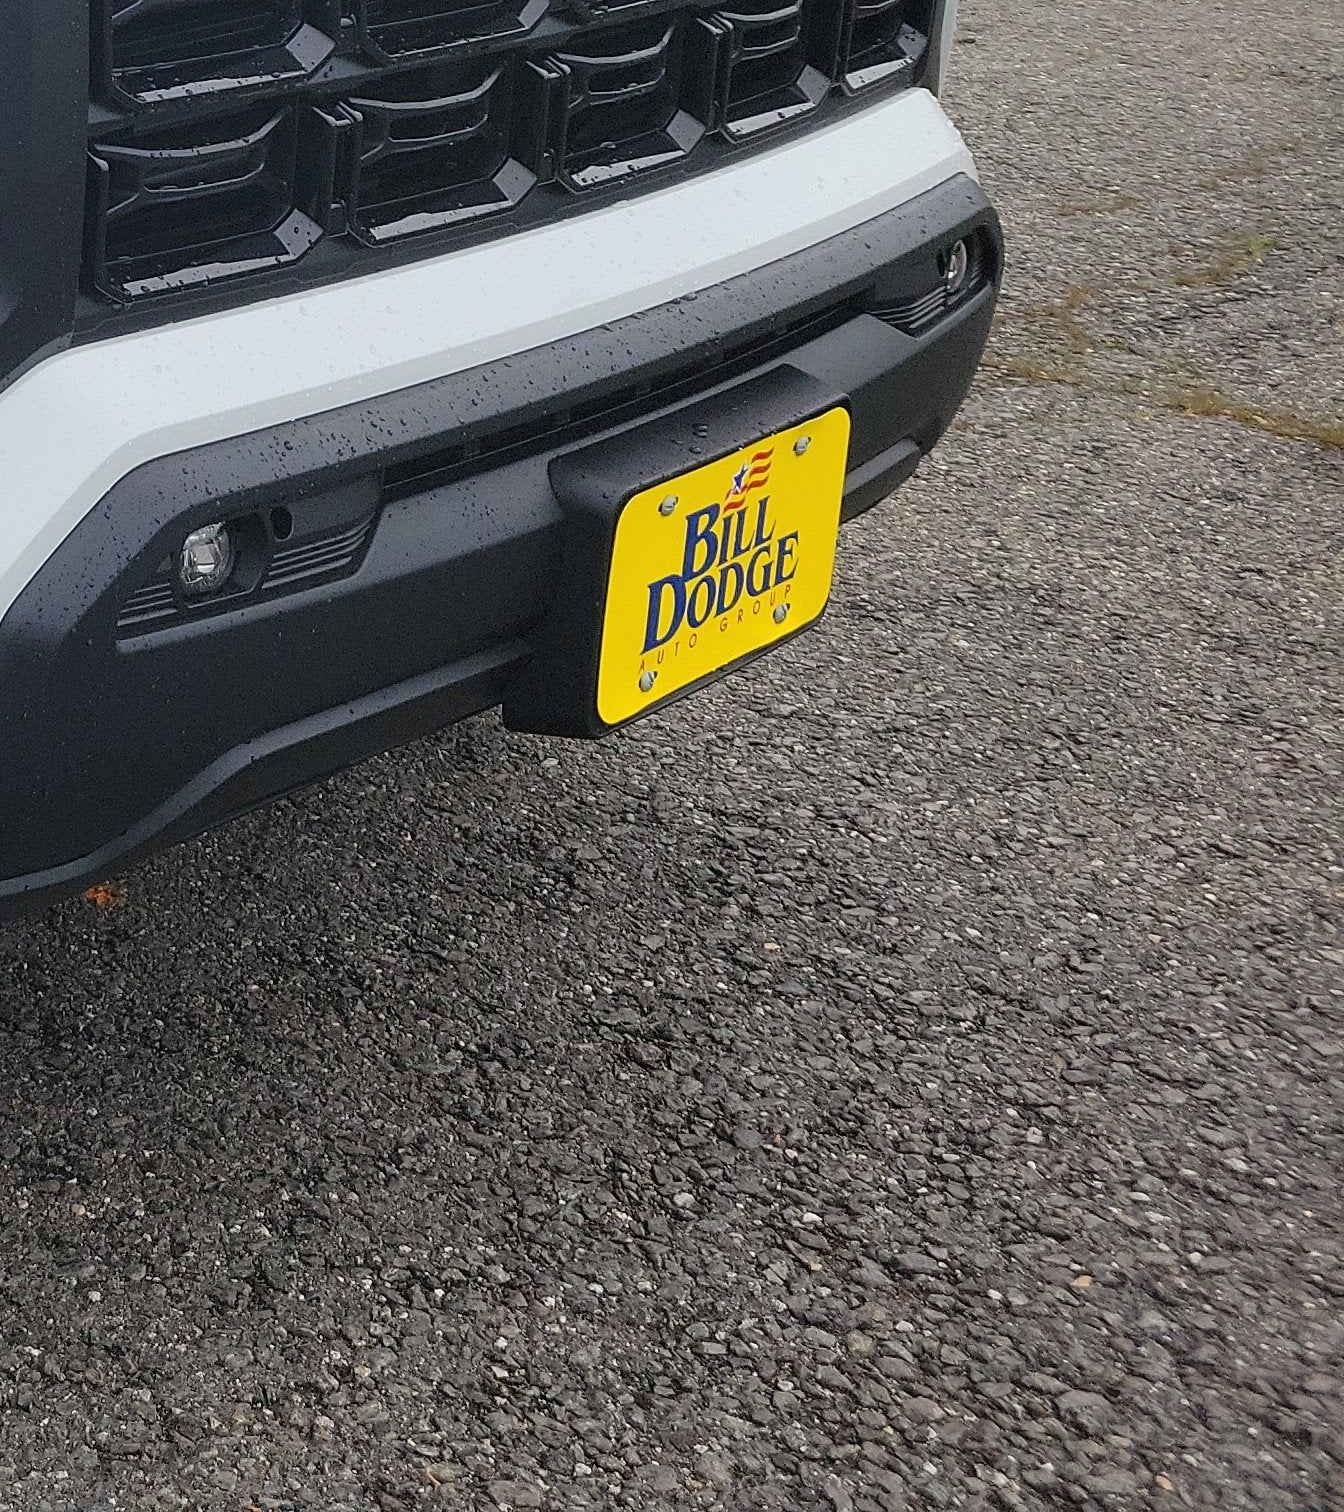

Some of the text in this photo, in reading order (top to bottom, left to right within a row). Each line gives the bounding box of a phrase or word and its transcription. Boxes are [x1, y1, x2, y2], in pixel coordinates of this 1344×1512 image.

[683, 496, 777, 581] BILL
[638, 585, 791, 673] AUTO GROUP
[640, 531, 799, 655] DODGE
